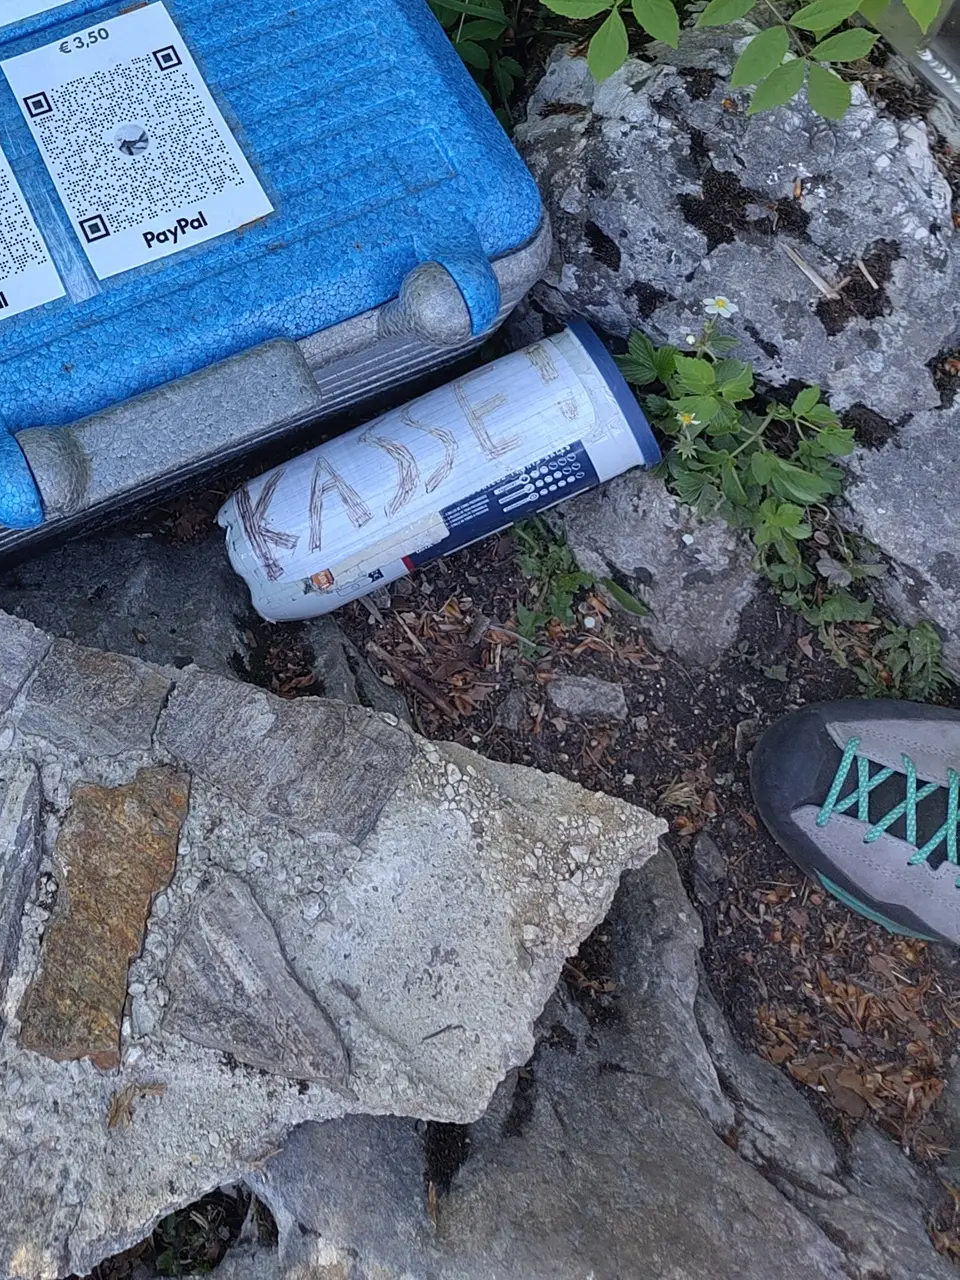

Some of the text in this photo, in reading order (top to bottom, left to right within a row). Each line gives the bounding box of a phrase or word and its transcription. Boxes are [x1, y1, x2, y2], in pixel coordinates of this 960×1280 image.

[58, 26, 110, 55] € 3,50
[141, 210, 209, 249] PayPal
